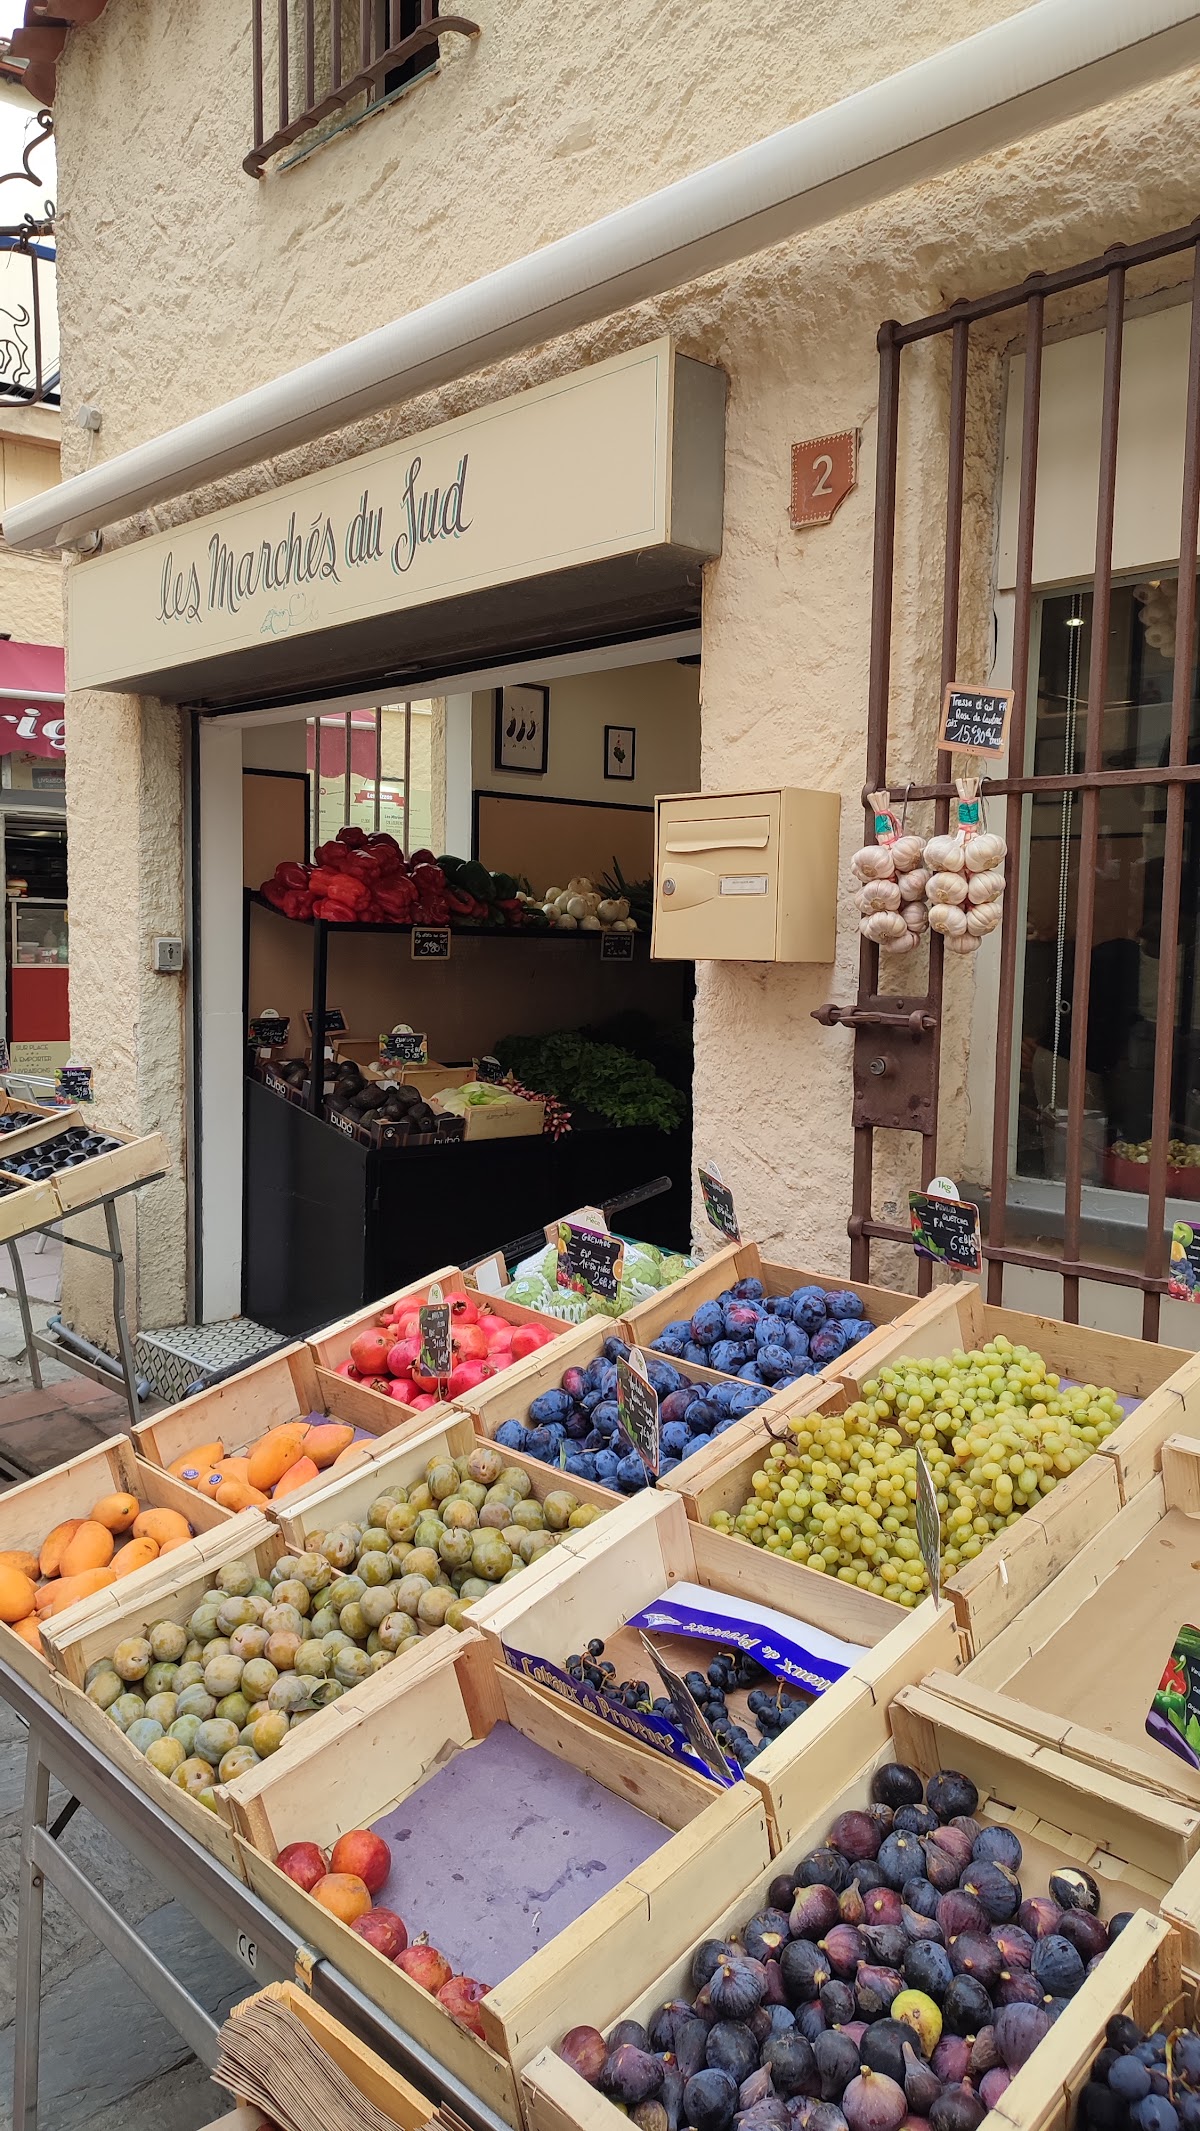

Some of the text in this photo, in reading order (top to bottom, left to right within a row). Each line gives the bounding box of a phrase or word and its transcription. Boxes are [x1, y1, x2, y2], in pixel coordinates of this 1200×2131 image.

[812, 454, 833, 496] 2
[155, 453, 474, 624] les Marchés du Sud
[951, 694, 973, 707] Tresse
[955, 708, 971, 720] Rose
[973, 712, 981, 722] de
[596, 1695, 675, 1753] Provence
[239, 1934, 255, 1966] CE
